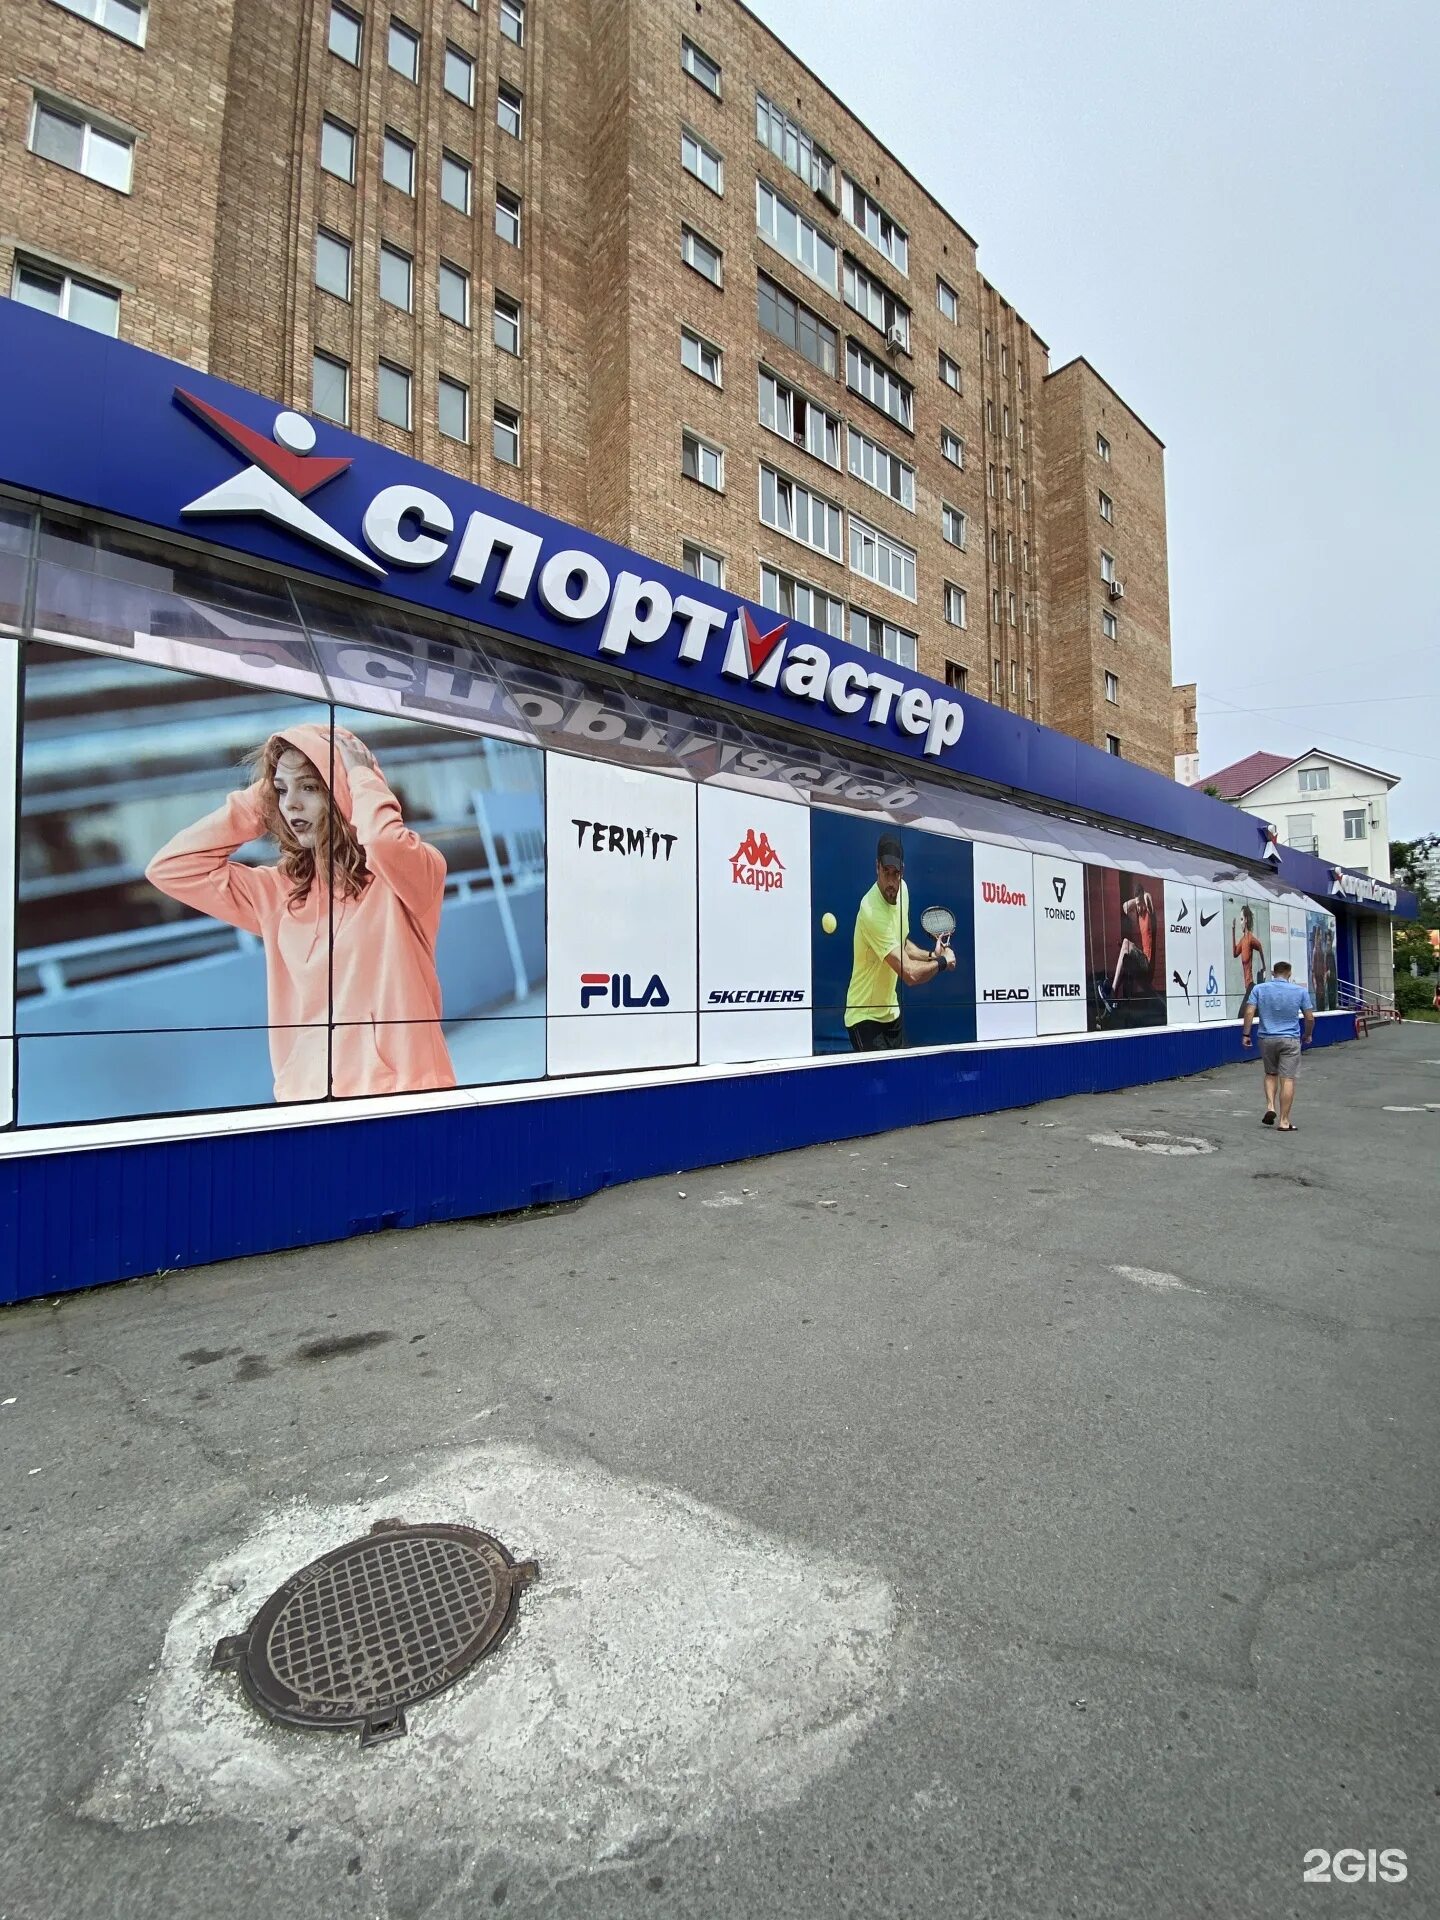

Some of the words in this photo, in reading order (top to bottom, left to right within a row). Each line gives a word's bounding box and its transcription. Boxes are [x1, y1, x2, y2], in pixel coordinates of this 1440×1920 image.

[732, 864, 783, 892] Kappa
[982, 881, 1027, 906] Wilson
[1045, 907, 1075, 921] TORNEO
[1170, 924, 1192, 934] DEMIX
[580, 973, 670, 1008] FILA
[707, 990, 805, 1004] SKECHERS
[983, 988, 1029, 1000] HEAD
[1042, 984, 1080, 997] KETTLER
